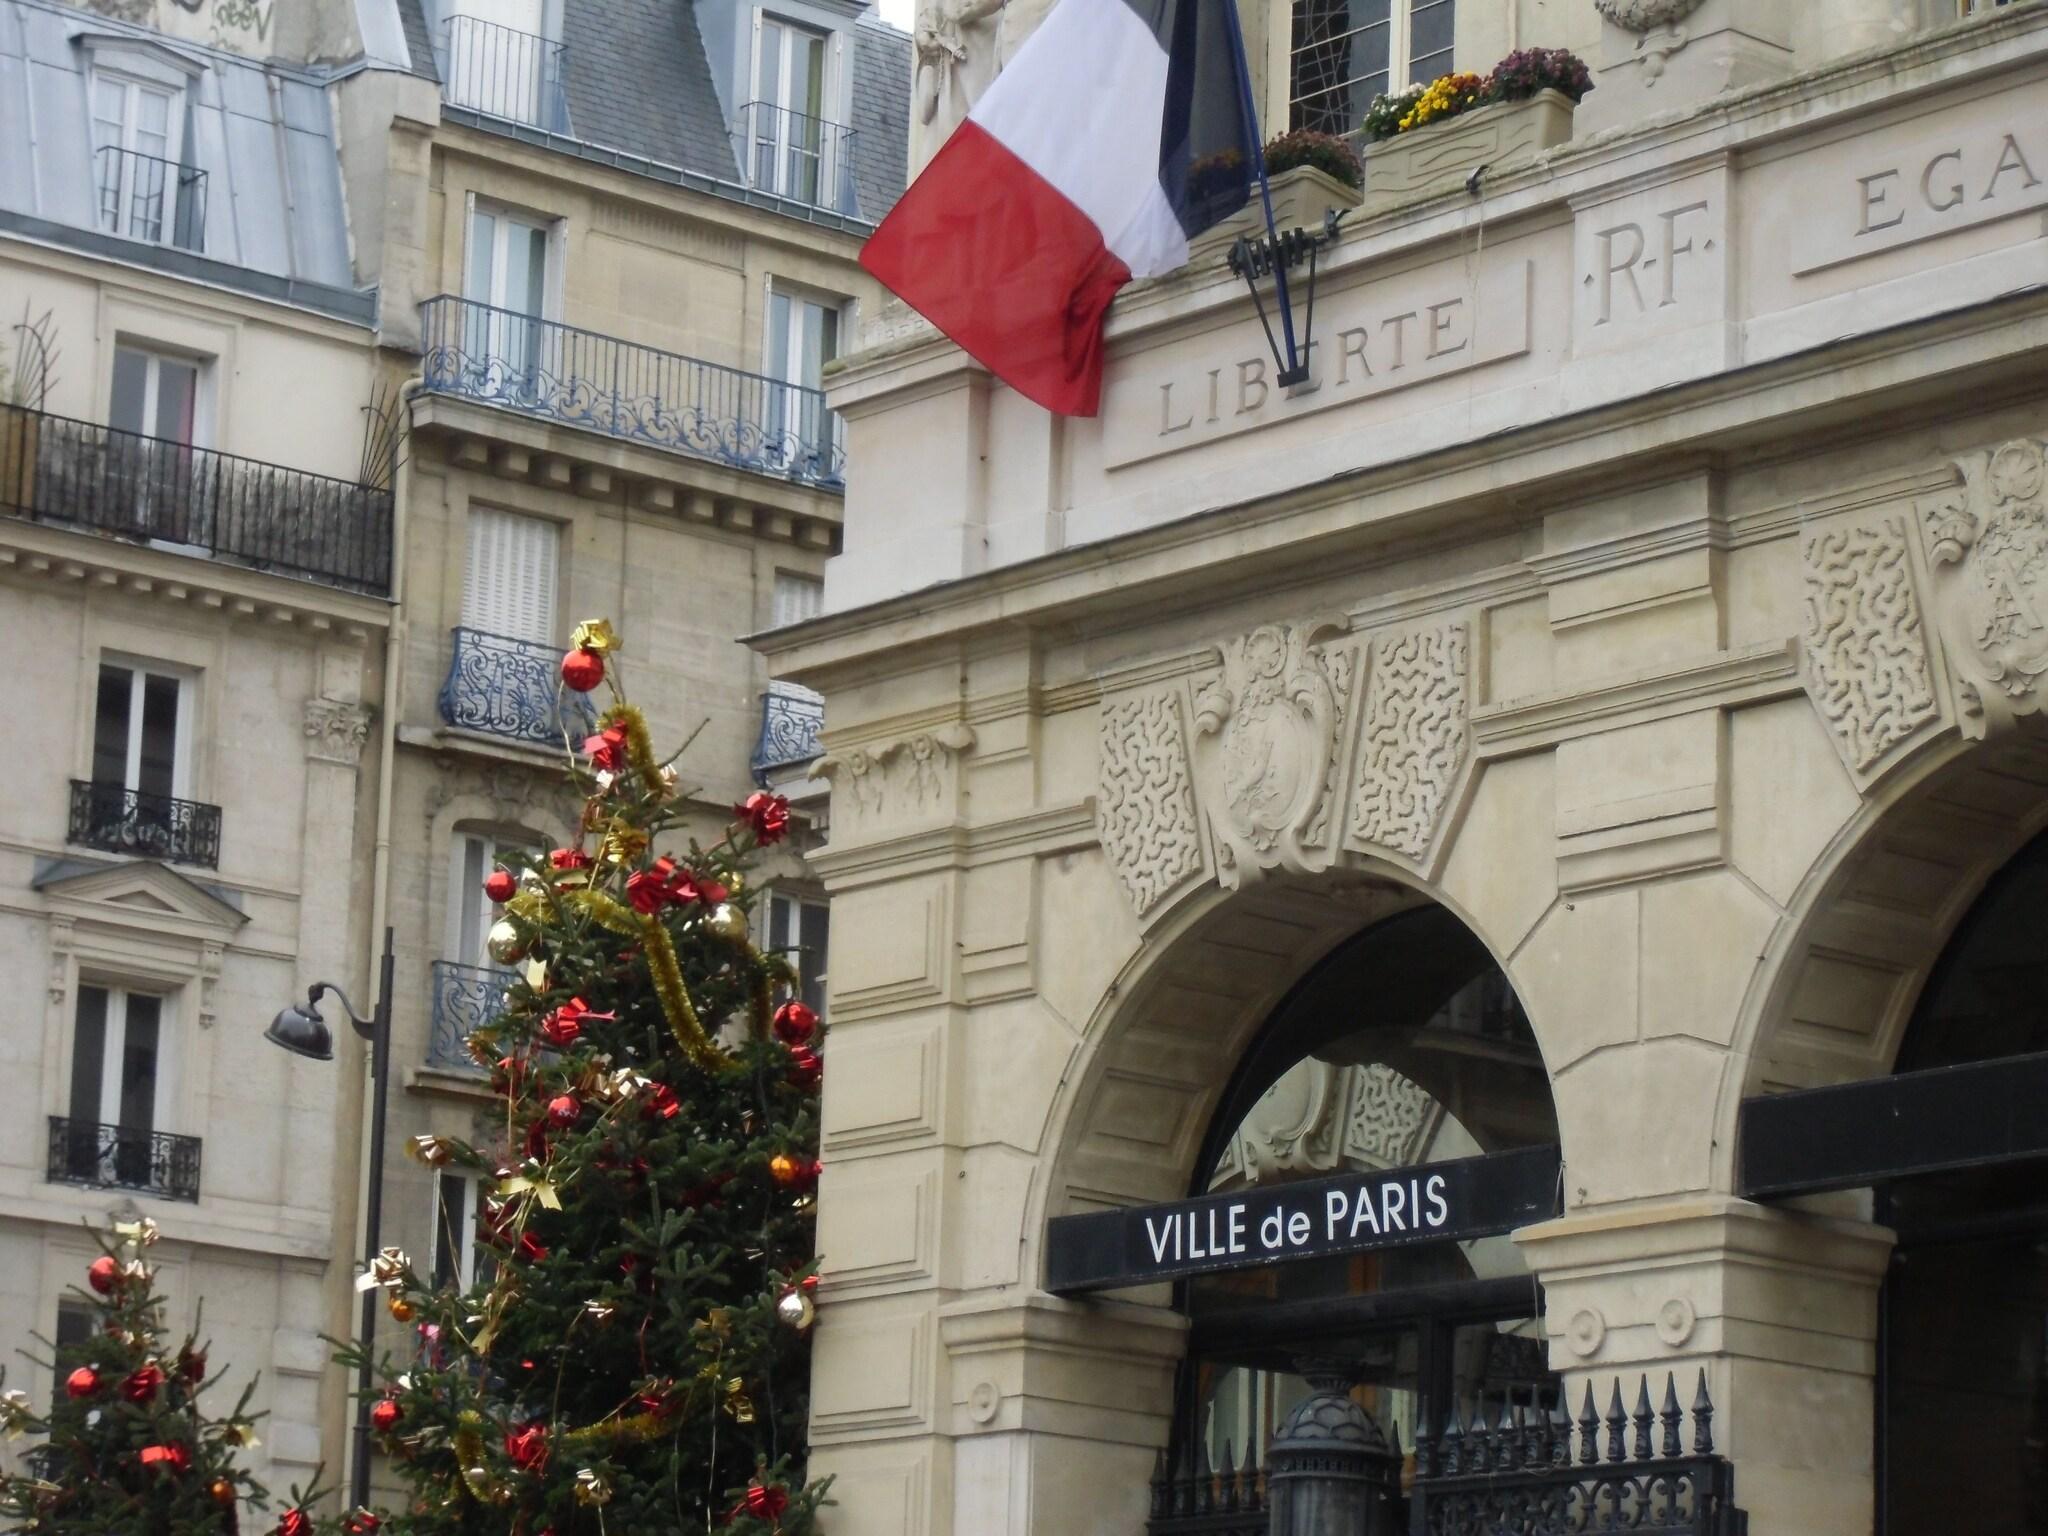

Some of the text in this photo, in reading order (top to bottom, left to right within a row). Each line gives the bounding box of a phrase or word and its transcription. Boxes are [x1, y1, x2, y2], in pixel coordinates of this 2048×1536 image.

[1854, 133, 2042, 236] EGA
[1145, 1175, 1448, 1263] VILLE de PARIS
